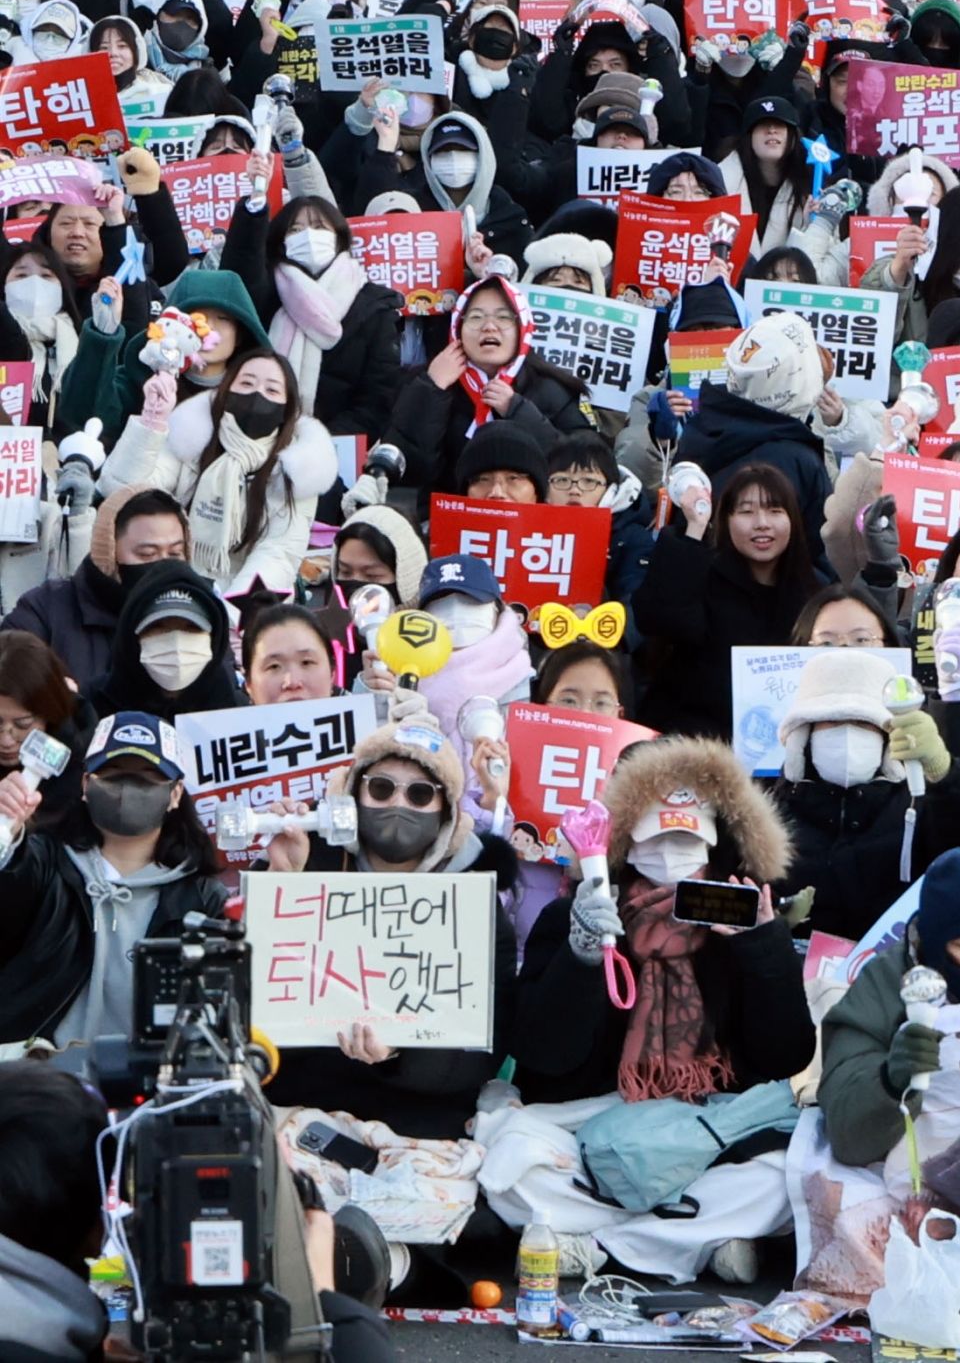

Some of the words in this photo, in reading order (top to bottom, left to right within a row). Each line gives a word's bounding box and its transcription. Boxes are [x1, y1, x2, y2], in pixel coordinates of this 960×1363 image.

[330, 31, 432, 58] 윤석열을
[331, 54, 434, 81] 탄핵하라
[894, 72, 958, 93] 반란수괴
[0, 77, 95, 138] 탄핵
[530, 310, 637, 359] 윤석열을
[459, 528, 575, 597] 탄핵
[514, 708, 550, 724] 나눔문화
[551, 716, 614, 734] www.nanum.com
[194, 709, 358, 786] 내란수괴
[538, 743, 607, 815] 탄
